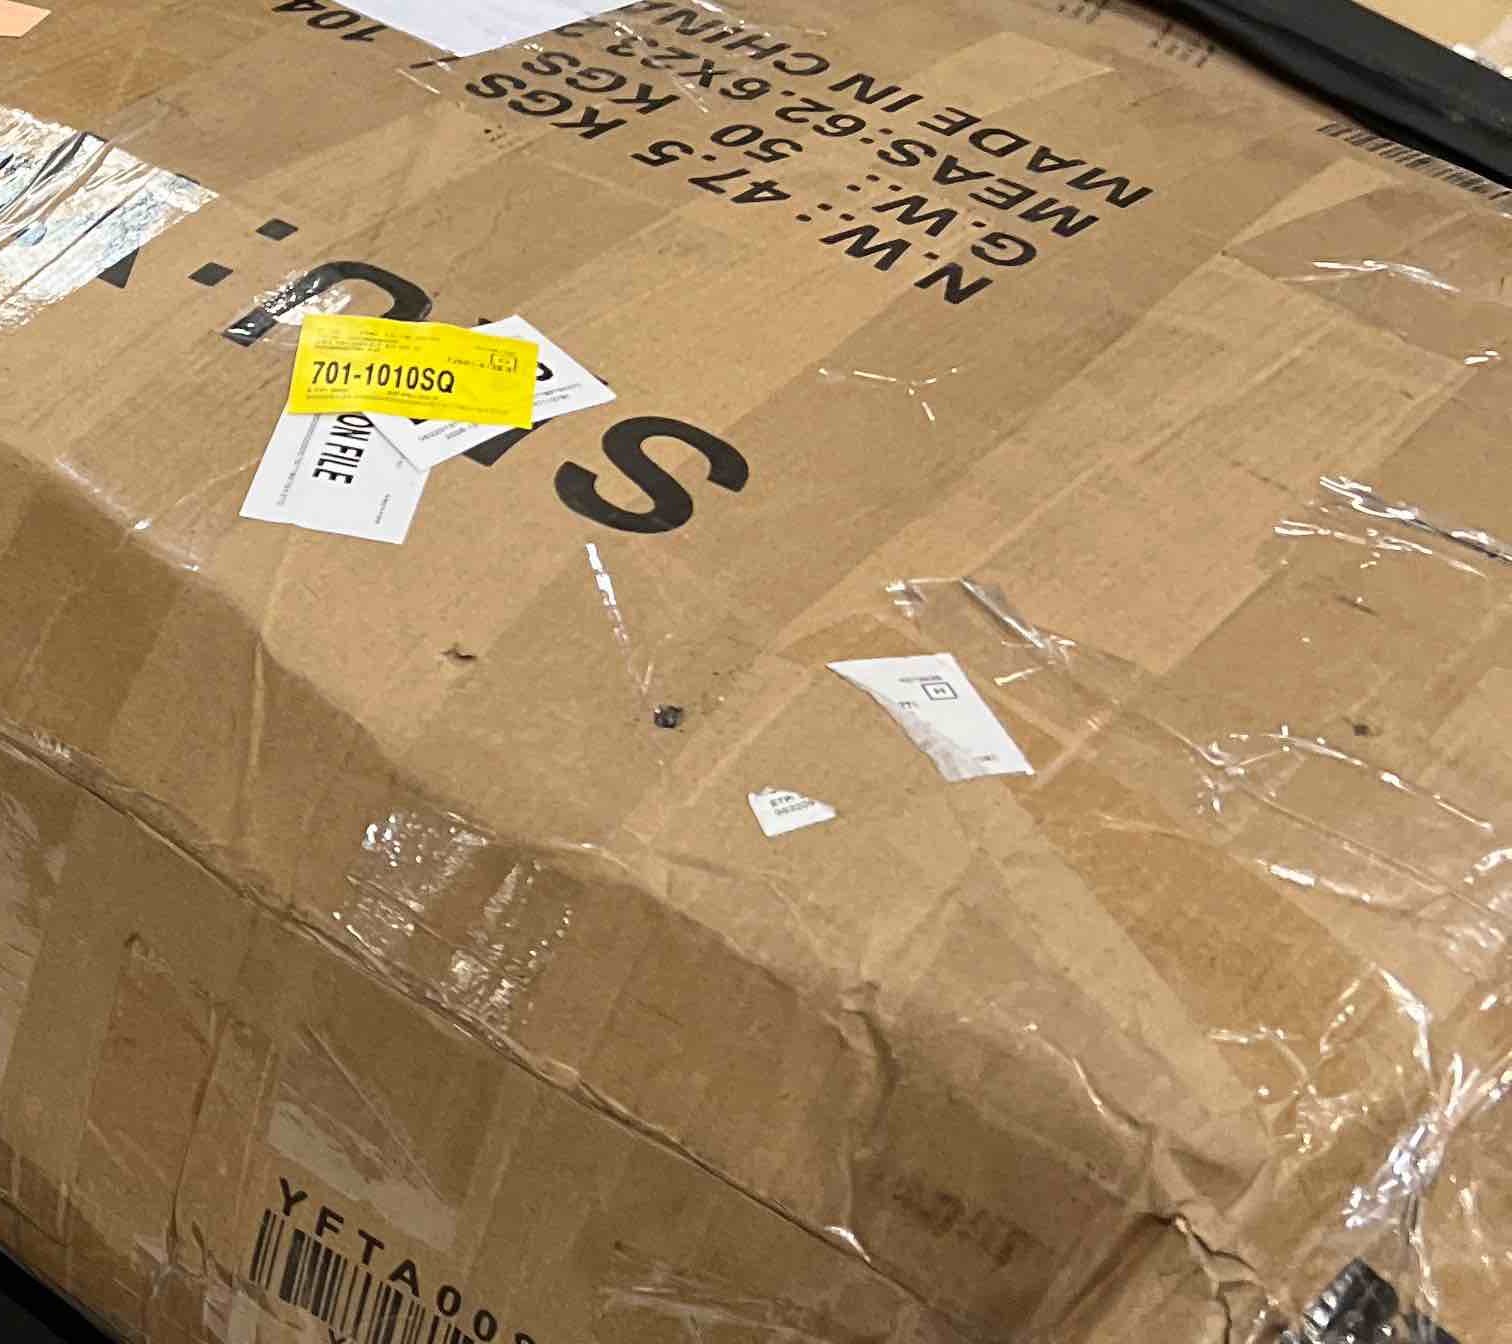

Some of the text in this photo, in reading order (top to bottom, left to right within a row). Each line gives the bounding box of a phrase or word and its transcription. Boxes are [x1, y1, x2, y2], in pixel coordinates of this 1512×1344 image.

[464, 71, 628, 141] KGS
[521, 51, 681, 115] KGS
[826, 71, 925, 114] IN
[630, 138, 792, 206] 47.5
[711, 123, 804, 164] 50
[917, 105, 1155, 210] MADE
[311, 360, 456, 394] 701-1010SQ
[312, 412, 375, 485] ON FILE
